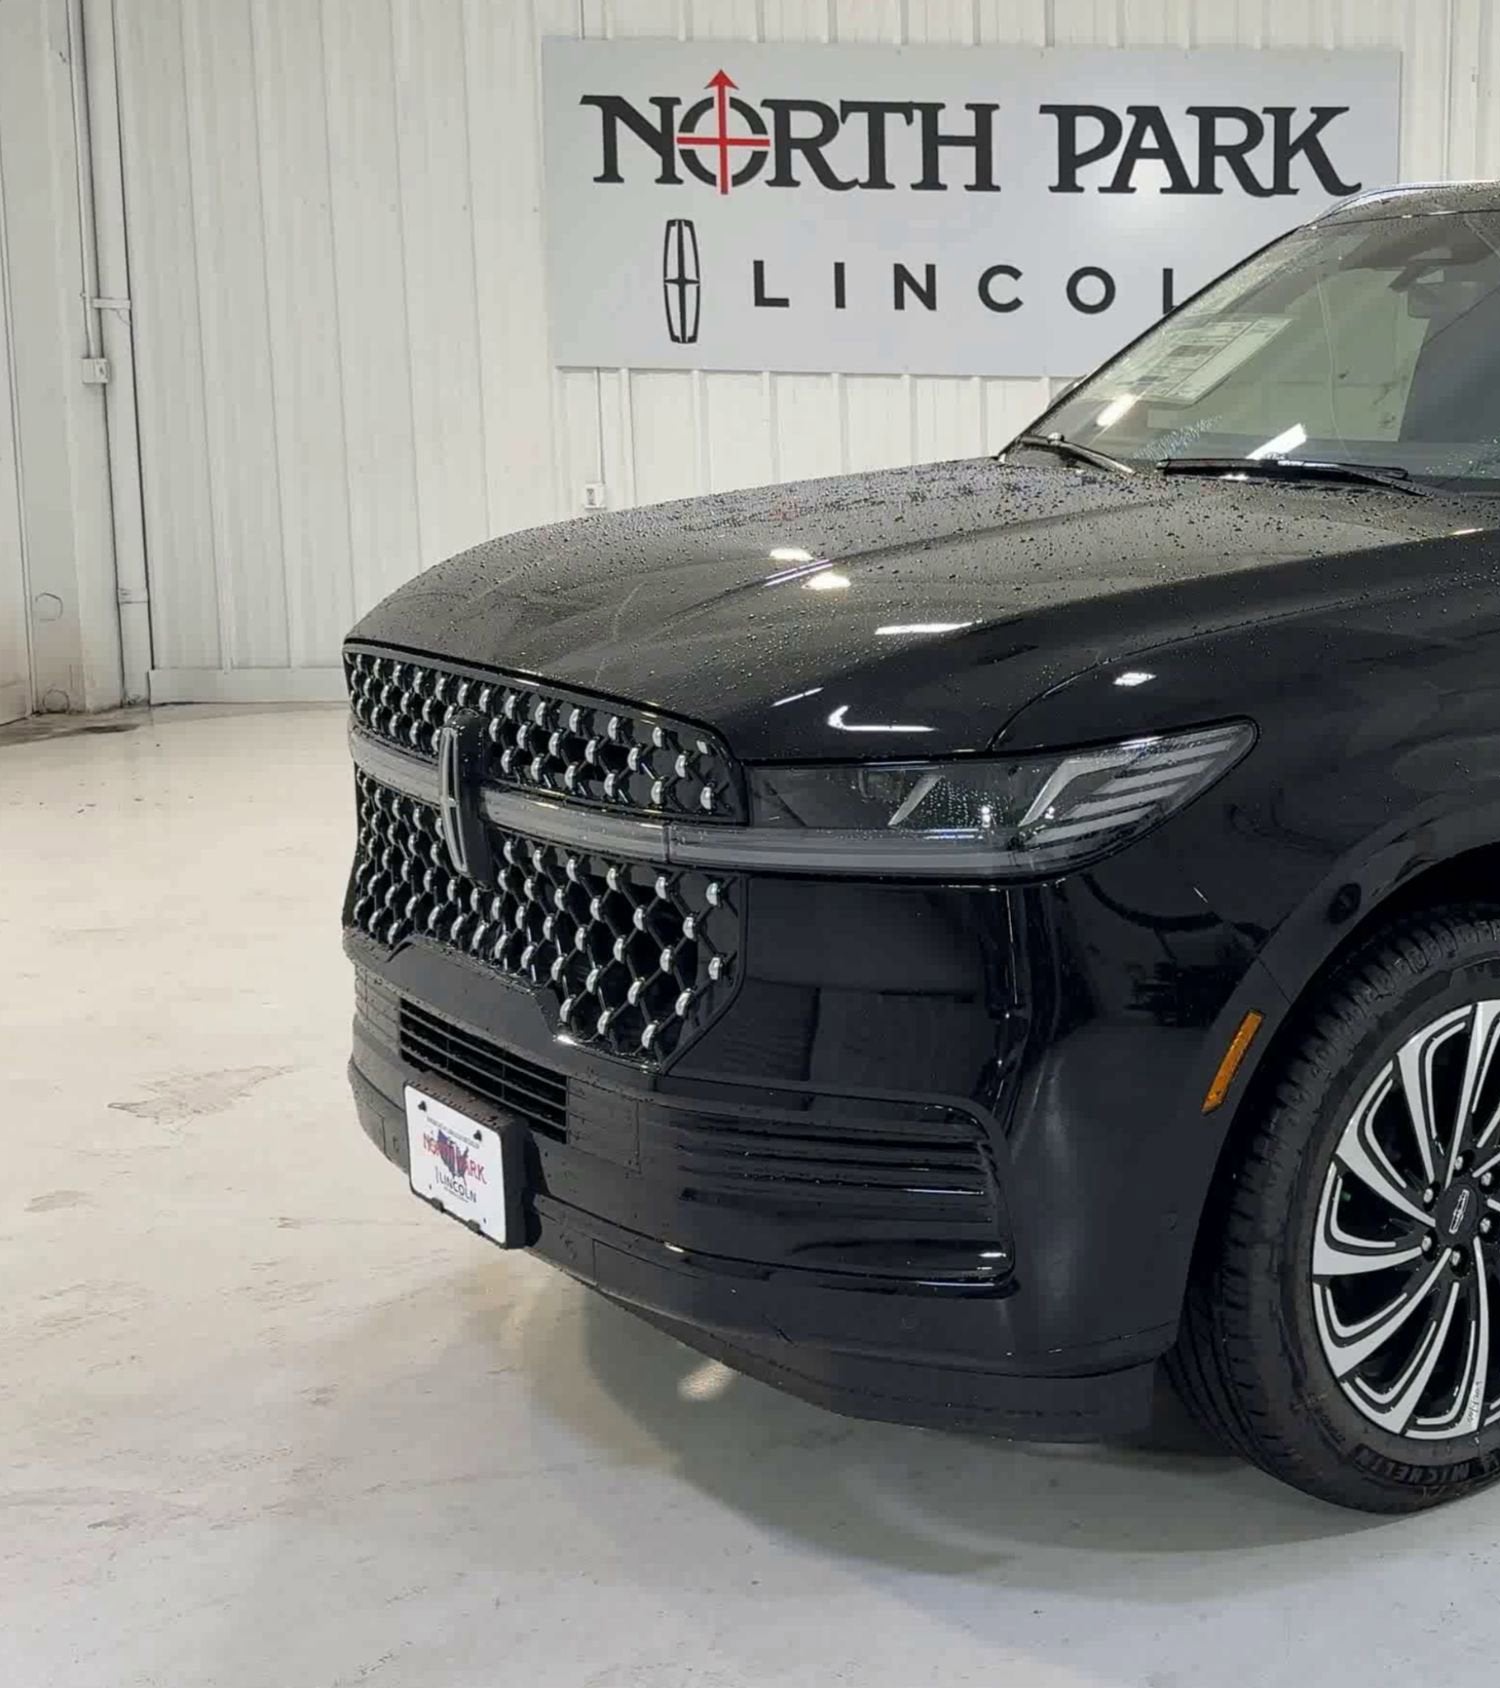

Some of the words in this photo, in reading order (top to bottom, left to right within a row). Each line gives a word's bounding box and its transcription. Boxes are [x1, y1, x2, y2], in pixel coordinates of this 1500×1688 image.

[580, 93, 1001, 193] NORTH
[1038, 103, 1363, 198] PARK
[752, 258, 1178, 315] LINCOL
[439, 1170, 477, 1203] LINCOLN
[1354, 1448, 1471, 1484] MICHELIN
